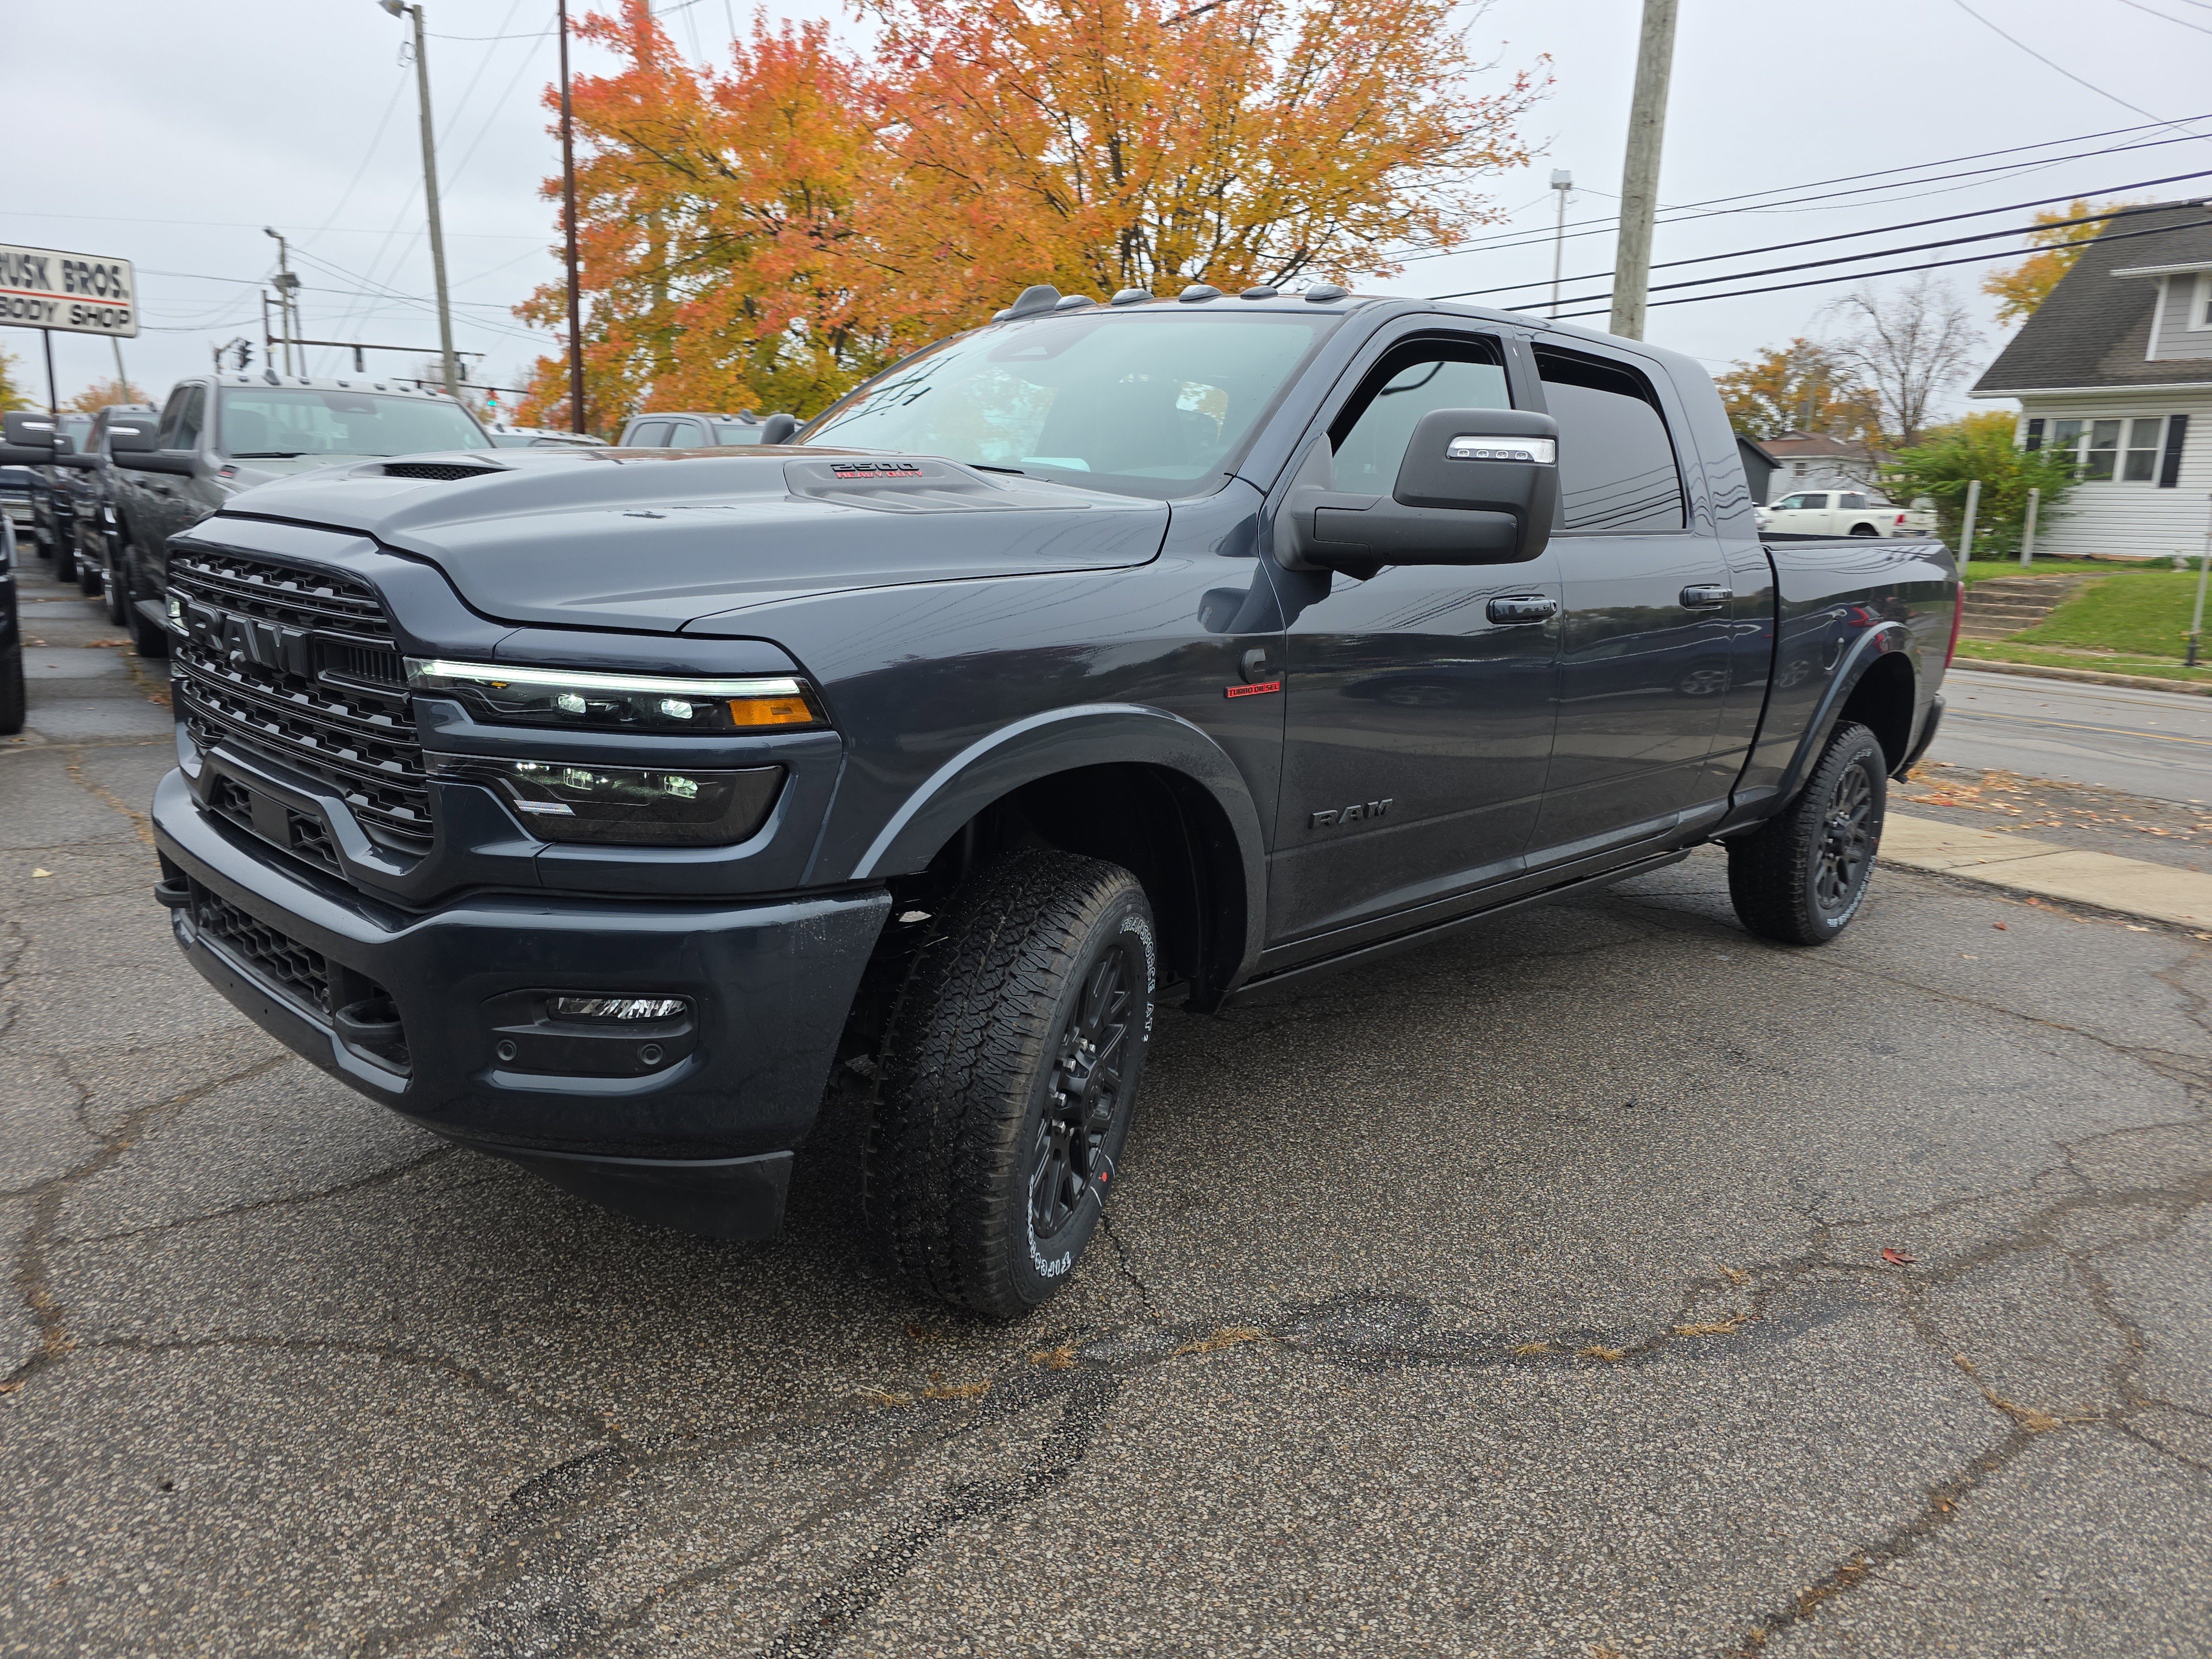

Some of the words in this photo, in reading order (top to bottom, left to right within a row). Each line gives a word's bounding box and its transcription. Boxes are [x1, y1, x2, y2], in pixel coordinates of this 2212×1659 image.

[0, 296, 61, 322] BODY
[69, 304, 130, 328] SHOP
[830, 463, 920, 472] 2500
[188, 601, 313, 678] RAM
[1229, 687, 1253, 697] TURBO
[1254, 684, 1279, 693] DIESEL
[1308, 798, 1393, 829] RAM
[1119, 916, 1156, 994] TRANSFORCE
